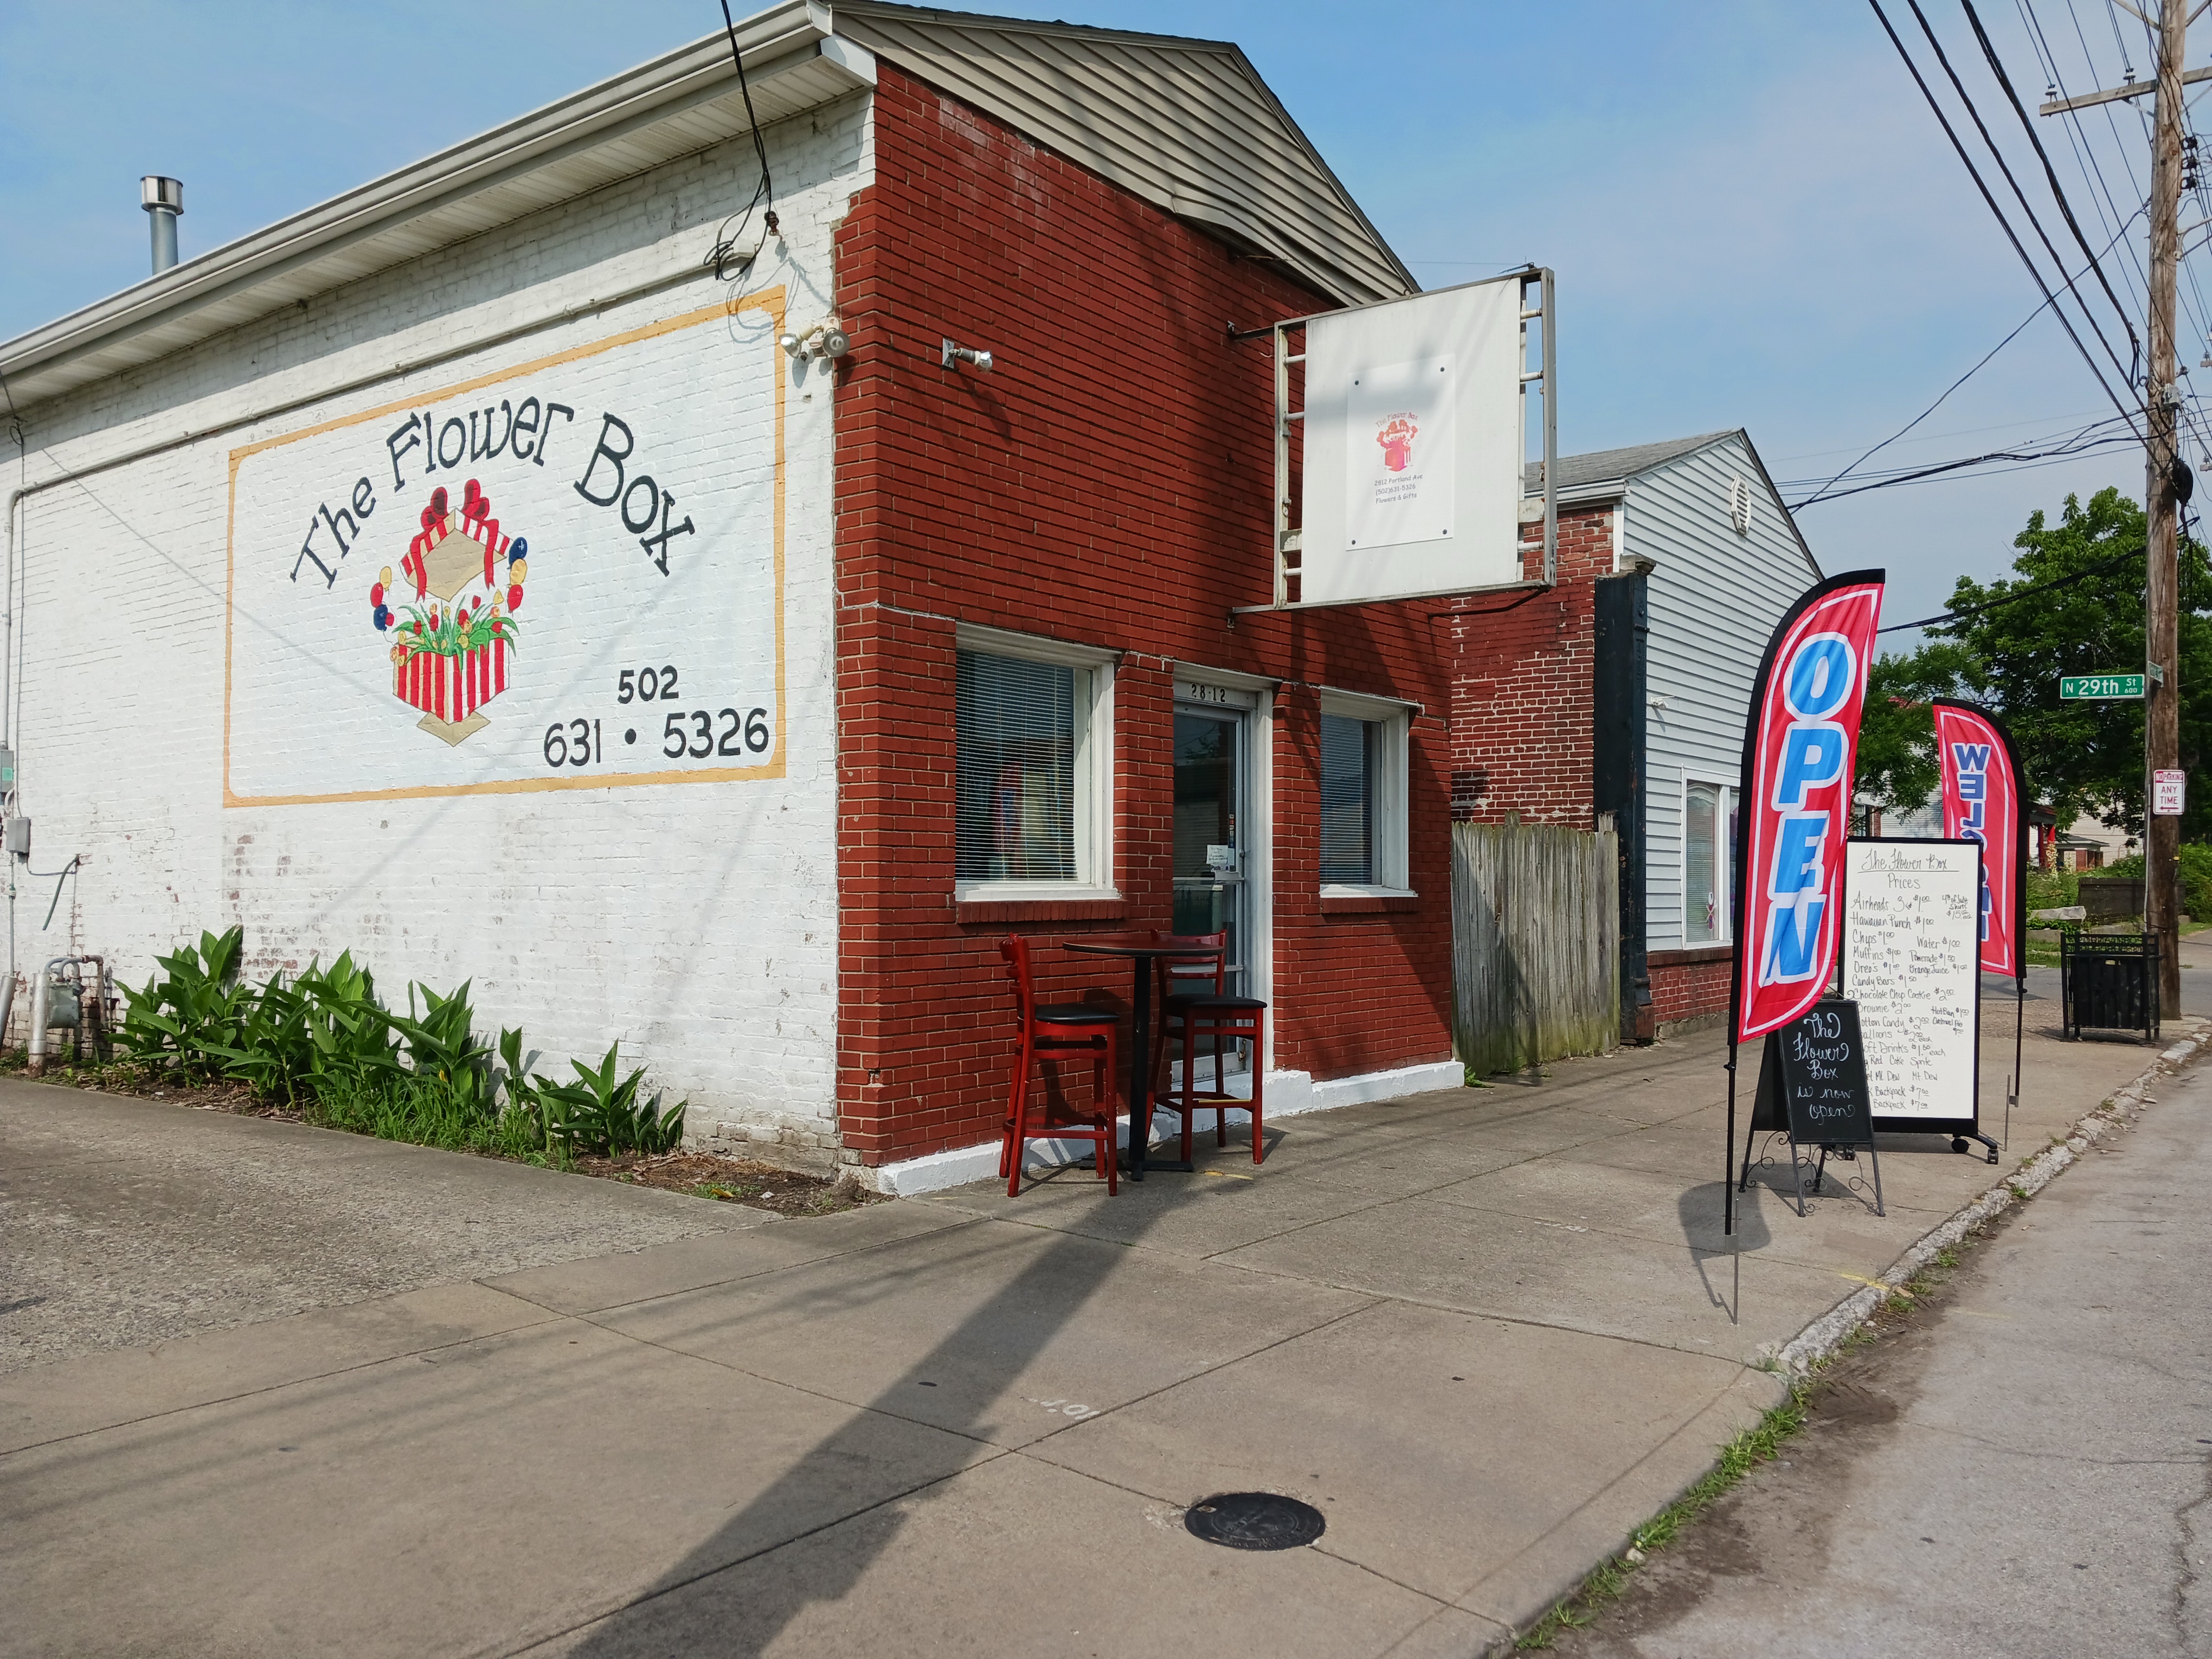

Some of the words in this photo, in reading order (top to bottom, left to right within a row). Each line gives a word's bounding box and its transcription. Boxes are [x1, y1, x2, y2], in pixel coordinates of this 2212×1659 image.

[1387, 413, 1407, 421] Flower
[1408, 411, 1418, 421] Box
[1388, 475, 1411, 484] Portland
[290, 477, 376, 589] The
[386, 396, 574, 493] Flower
[573, 411, 695, 576] Box
[1375, 483, 1416, 496] (502)631-5326
[618, 665, 679, 703] 502
[2066, 683, 2073, 693] N
[2079, 679, 2119, 695] 29th
[2126, 678, 2137, 686] St
[543, 718, 601, 767] 631
[663, 708, 769, 758] 5326
[2156, 773, 2163, 781] NO
[2161, 786, 2177, 794] ANY
[1762, 633, 1855, 986] OPEN
[1861, 848, 1887, 870] The
[1889, 848, 1921, 870] Flower
[1926, 853, 1947, 870] Box
[1888, 873, 1921, 889] Prices
[1850, 890, 1889, 911] Airheads
[1893, 896, 1905, 912] 3
[1951, 895, 1957, 903] of
[1956, 895, 1969, 904] July
[1887, 914, 1912, 929] Punch
[1853, 929, 1876, 947] Chips
[1917, 936, 1940, 949] Water
[1853, 946, 1884, 960] Muffins
[1908, 950, 1938, 962] Powerade
[1853, 974, 1875, 991] Candy
[1876, 976, 1895, 986] Bars
[1854, 988, 1887, 1000] Chocolate
[1889, 988, 1905, 1002] Chip
[1908, 989, 1931, 1000] Cookie
[1804, 1013, 1840, 1038] The
[1861, 1017, 1880, 1027] otton
[1883, 1016, 1905, 1033] Candy
[1861, 1029, 1892, 1039] alloons
[1793, 1032, 1849, 1061] Flower
[1863, 1041, 1877, 1053] oft
[1878, 1041, 1908, 1053] Drinks
[1930, 1049, 1946, 1057] each
[1807, 1059, 1838, 1079] Box
[1869, 1054, 1883, 1065] Red
[1890, 1054, 1904, 1065] Coke
[1910, 1057, 1933, 1069] Sprite
[1887, 1070, 1900, 1081] Dew
[1924, 1070, 1938, 1081] Dew
[1797, 1082, 1813, 1098] is
[1820, 1089, 1854, 1098] now
[1875, 1085, 1907, 1099] Backpack
[1873, 1098, 1907, 1111] Backpack
[1810, 1104, 1855, 1125] open
